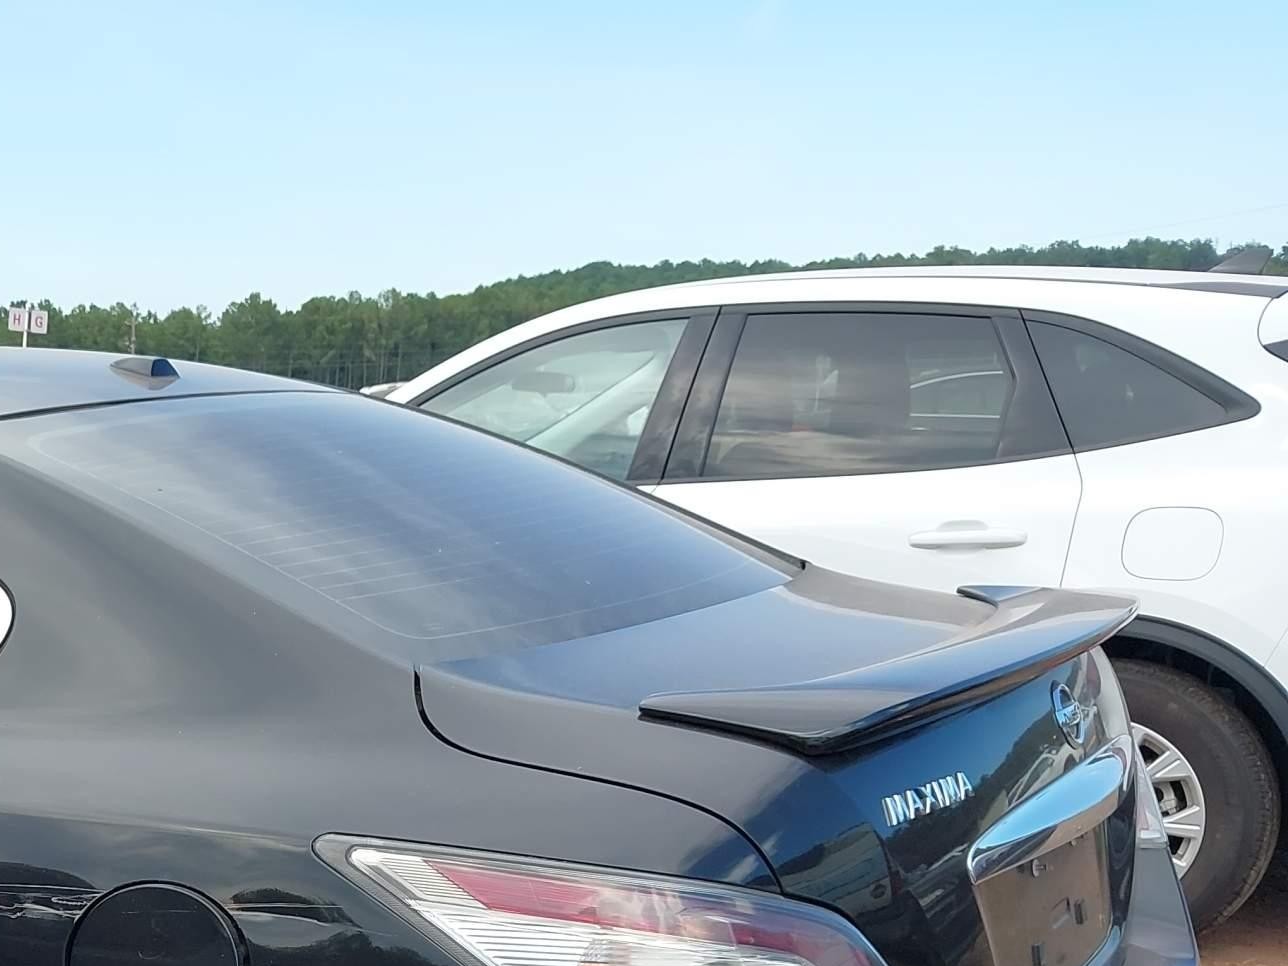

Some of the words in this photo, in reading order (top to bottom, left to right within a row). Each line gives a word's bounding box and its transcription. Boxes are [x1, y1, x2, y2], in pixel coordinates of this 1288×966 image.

[13, 313, 22, 326] H
[35, 316, 43, 328] G
[881, 771, 975, 827] MAXIMA
